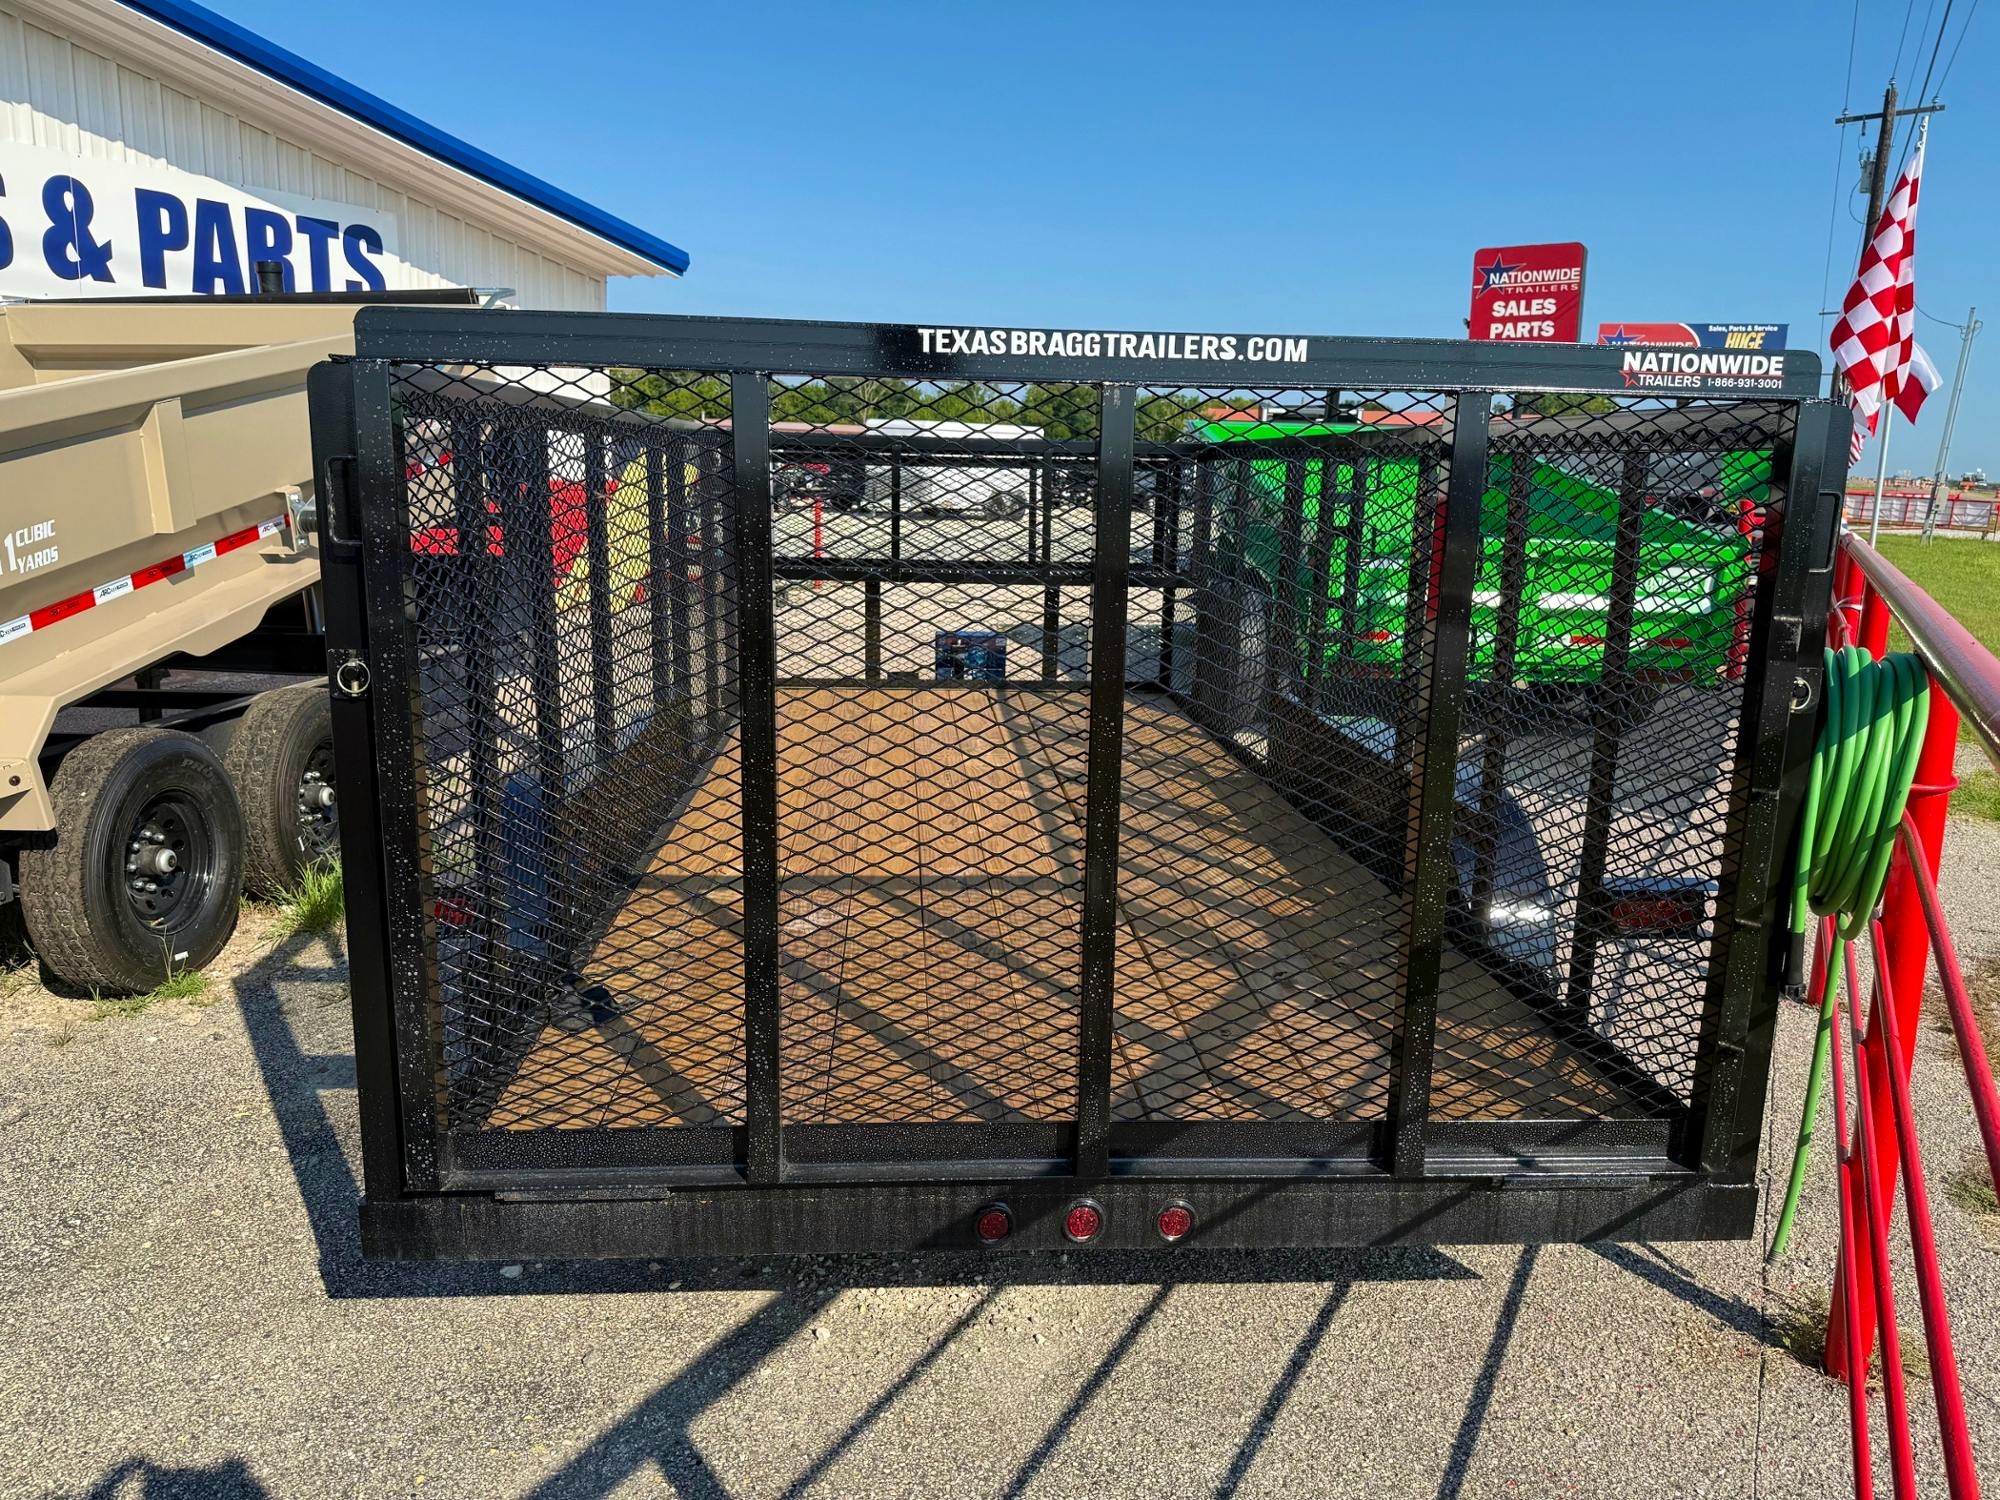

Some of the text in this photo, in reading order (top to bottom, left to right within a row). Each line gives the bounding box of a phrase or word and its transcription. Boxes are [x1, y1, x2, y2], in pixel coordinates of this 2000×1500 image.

[41, 174, 116, 284] &
[134, 187, 387, 296] PARTS
[1489, 267, 1581, 285] NATIONWIDE
[1506, 283, 1579, 295] TRAILERS
[1491, 298, 1557, 318] SALES
[1489, 320, 1555, 340] PARTS
[1622, 352, 1785, 376] NATIONWIDE
[1638, 374, 1783, 390] TRAILERS 1-866-931-3001
[15, 519, 56, 548] CUBIC
[17, 546, 59, 574] YARDS
